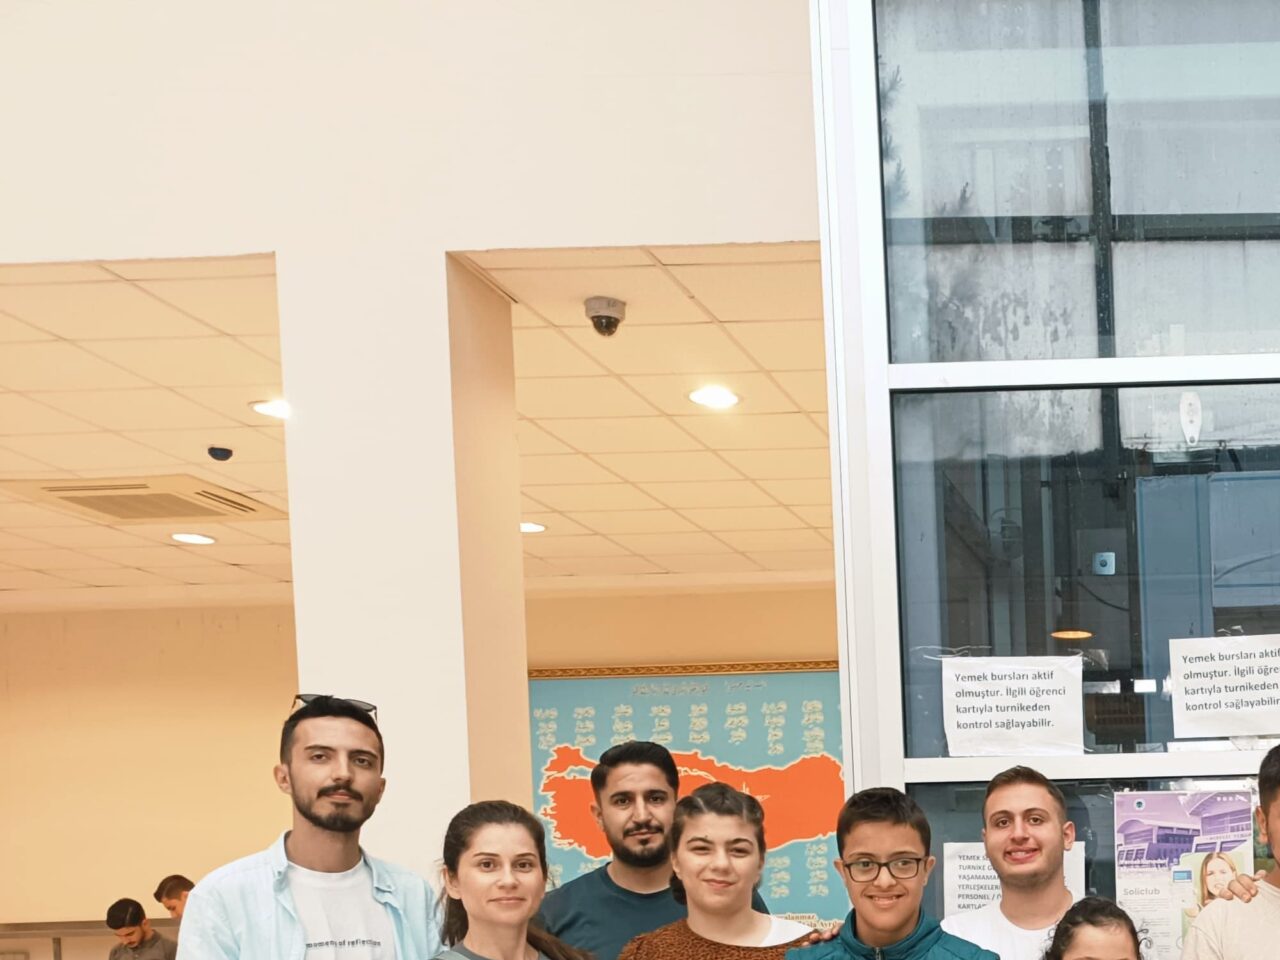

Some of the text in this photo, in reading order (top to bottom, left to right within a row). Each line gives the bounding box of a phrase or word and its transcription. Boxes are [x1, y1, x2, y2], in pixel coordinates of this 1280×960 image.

[1182, 653, 1216, 664] Yemek
[1218, 651, 1256, 661] bursları
[955, 670, 1054, 682] Yemek bursları aktif
[1183, 669, 1232, 680] olmuştur.
[1234, 665, 1255, 677] İlgili
[955, 685, 1066, 699] olmuştur. İlgili öğrenci
[1184, 681, 1279, 696] kartıyla turnikeden
[956, 703, 1051, 715] kartıyla turnikeden
[1185, 701, 1222, 711] kontrol
[956, 718, 1055, 731] kontrol sağlayabilir.
